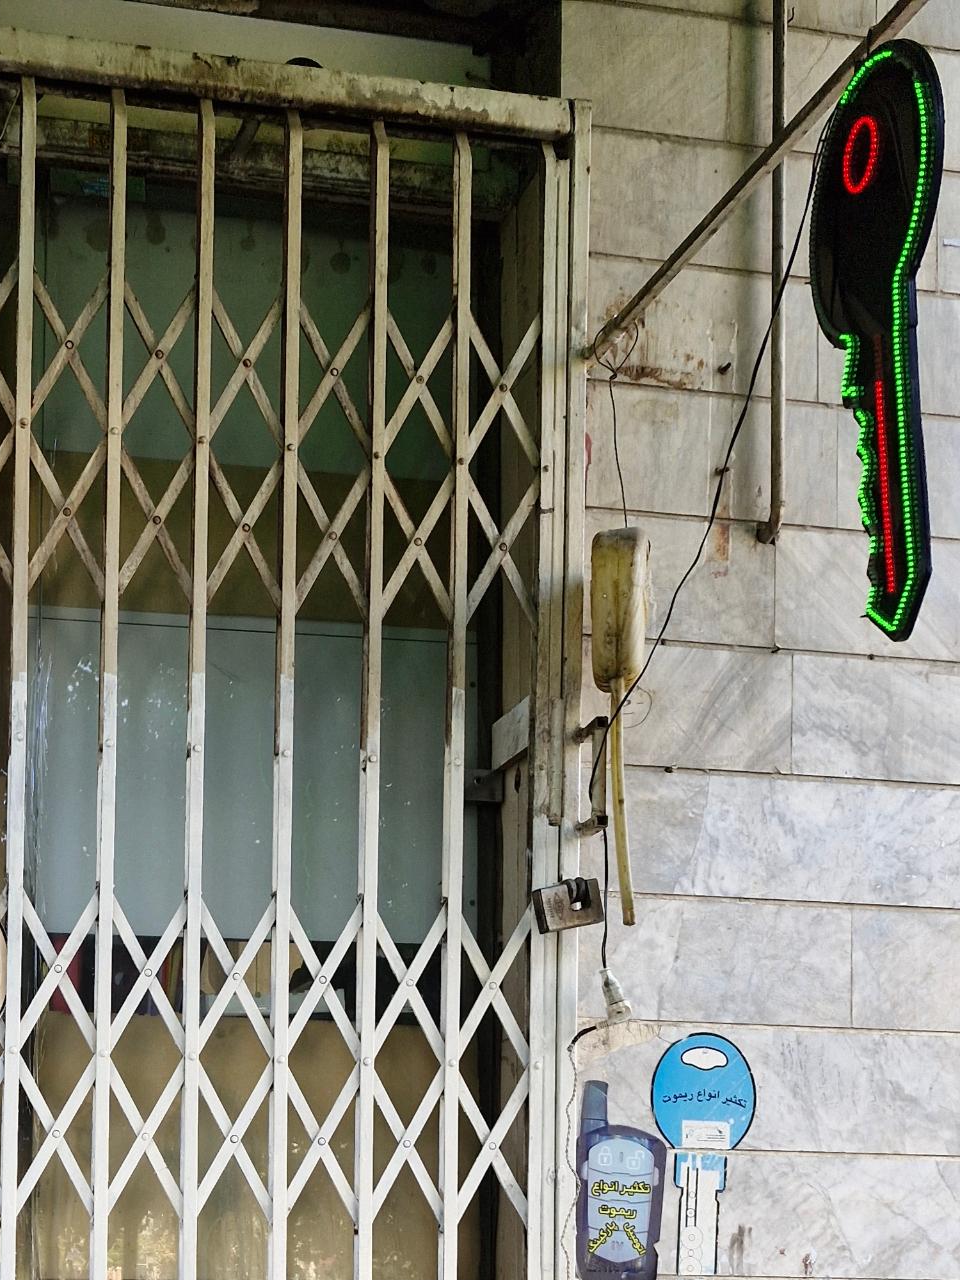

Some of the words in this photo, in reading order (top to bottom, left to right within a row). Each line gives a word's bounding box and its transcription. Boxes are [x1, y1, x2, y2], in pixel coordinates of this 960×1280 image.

[662, 1092, 693, 1103] ریموت
[696, 1088, 720, 1102] انواع
[721, 1095, 748, 1109] تکثیر
[592, 1180, 619, 1196] انواع
[620, 1181, 651, 1195] تکثیر
[598, 1205, 637, 1219] ریموت
